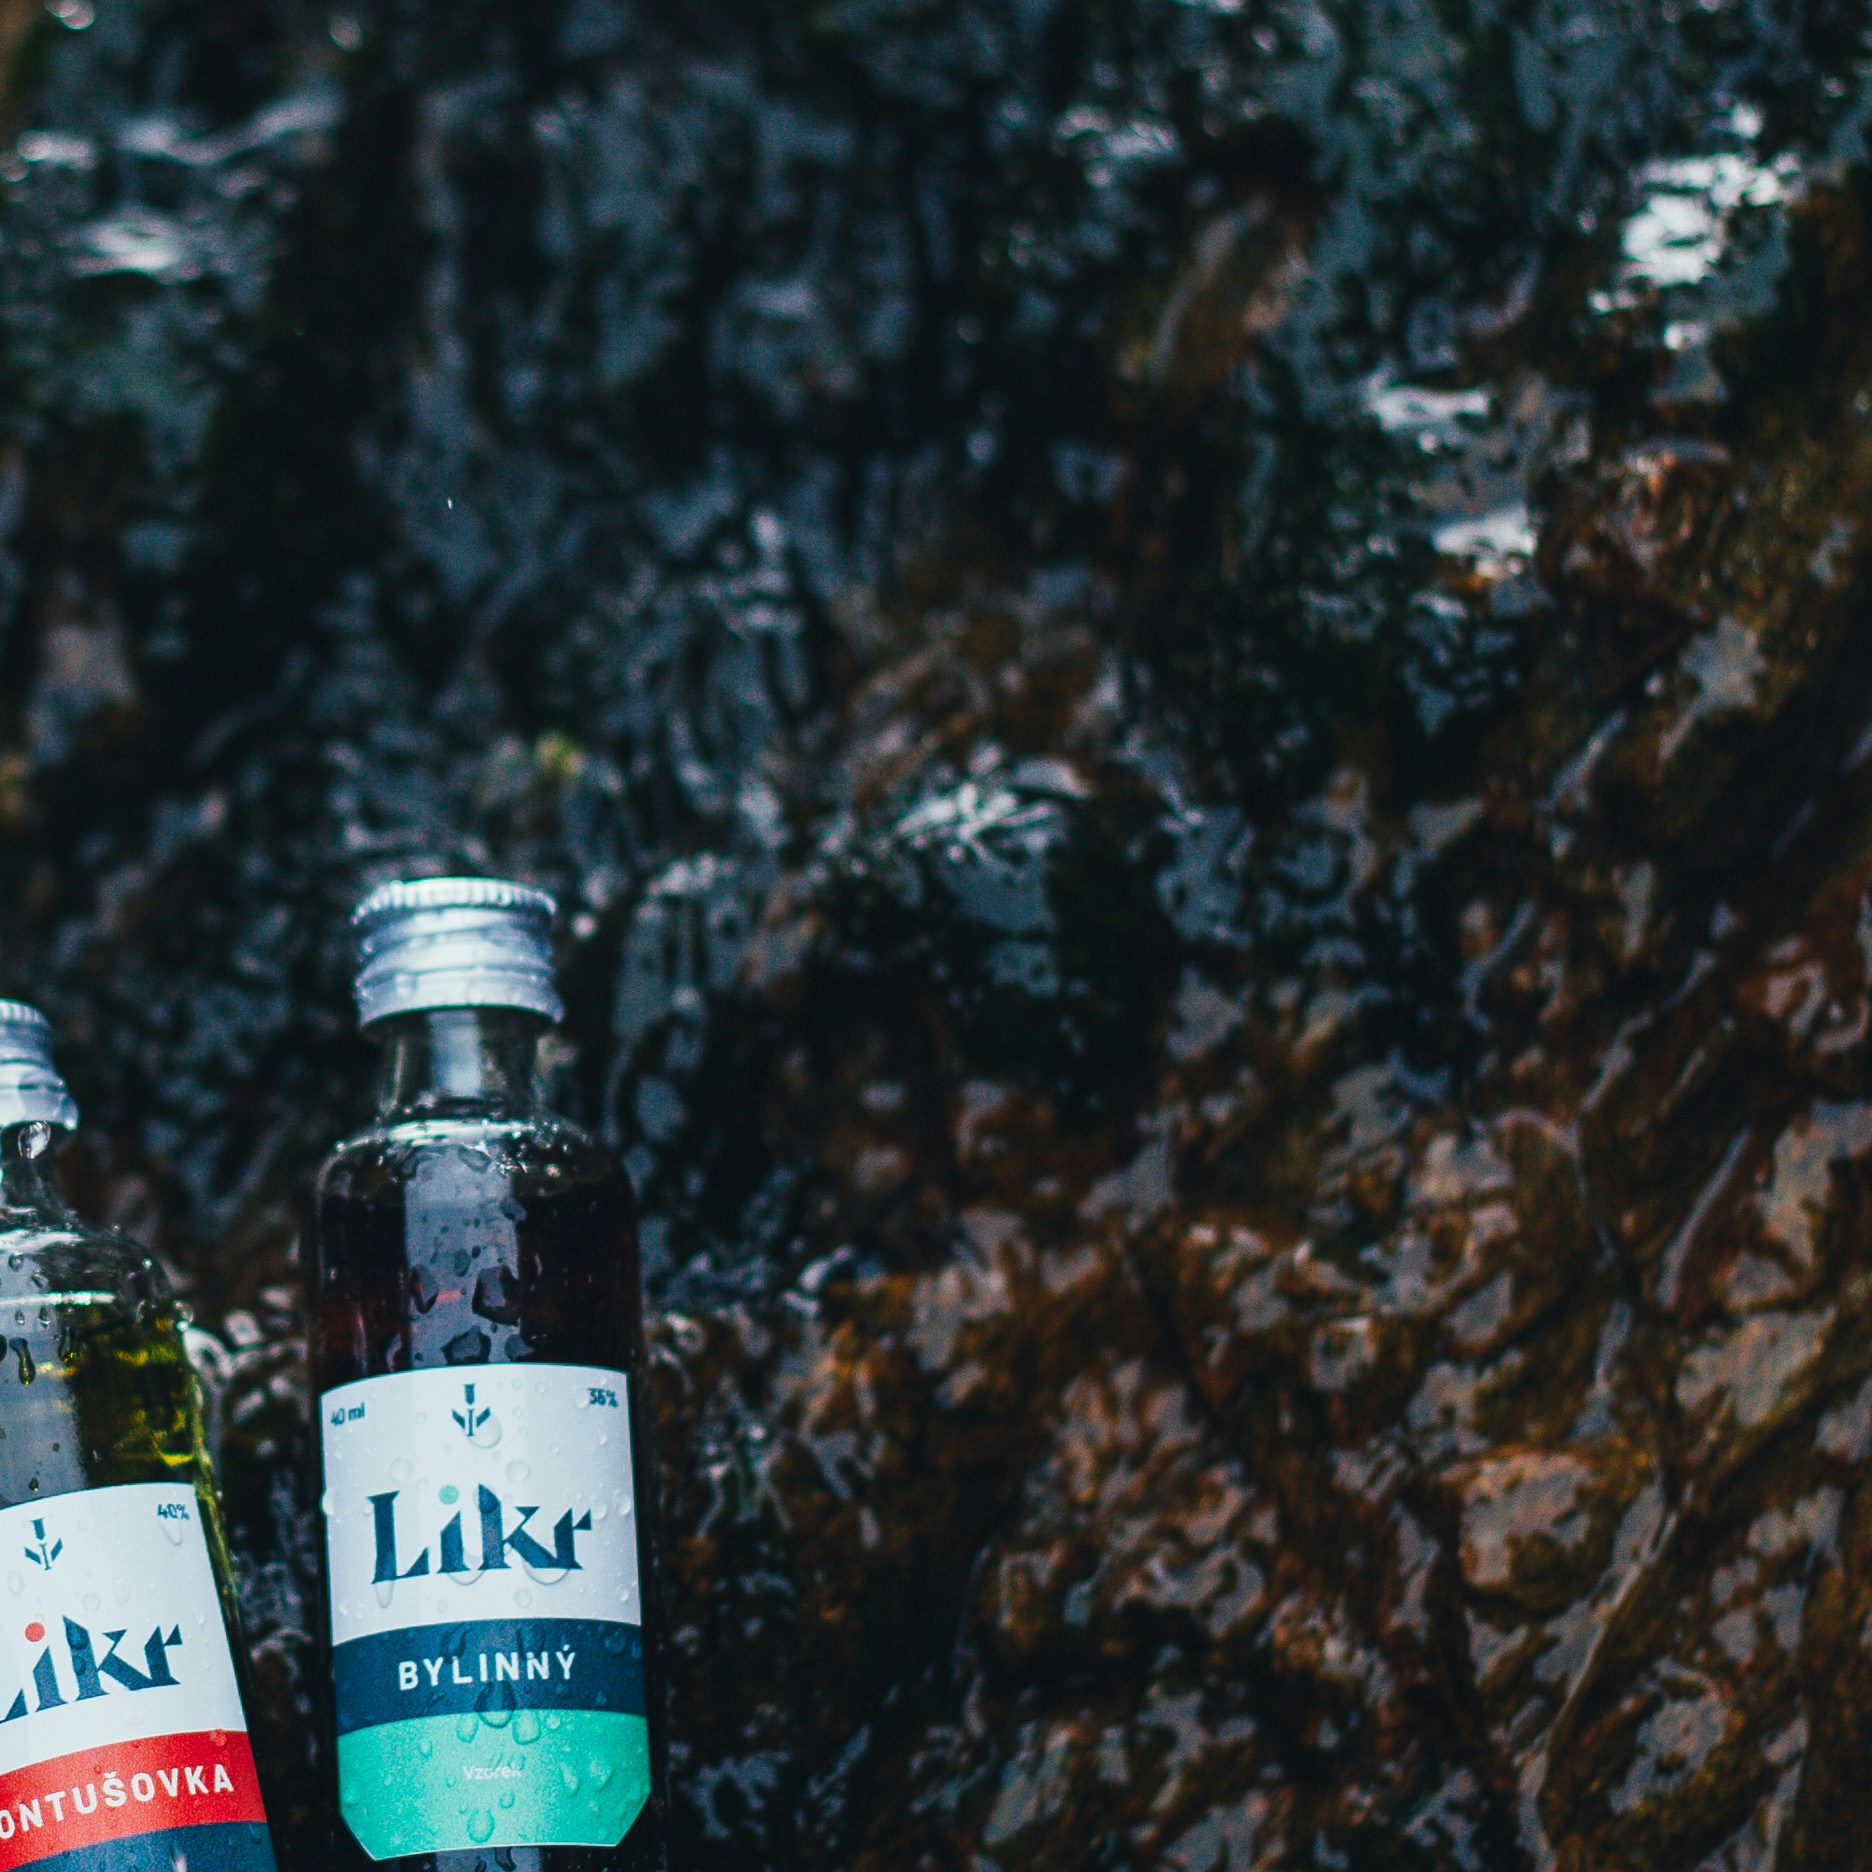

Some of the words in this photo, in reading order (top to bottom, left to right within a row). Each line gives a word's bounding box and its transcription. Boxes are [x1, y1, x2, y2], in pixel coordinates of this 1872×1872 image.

[348, 1401, 365, 1421] ml
[157, 1503, 190, 1521] 40%
[366, 1483, 592, 1585] Likr
[397, 1643, 577, 1691] BYLINNÝ
[462, 1764, 522, 1781] Vzorek
